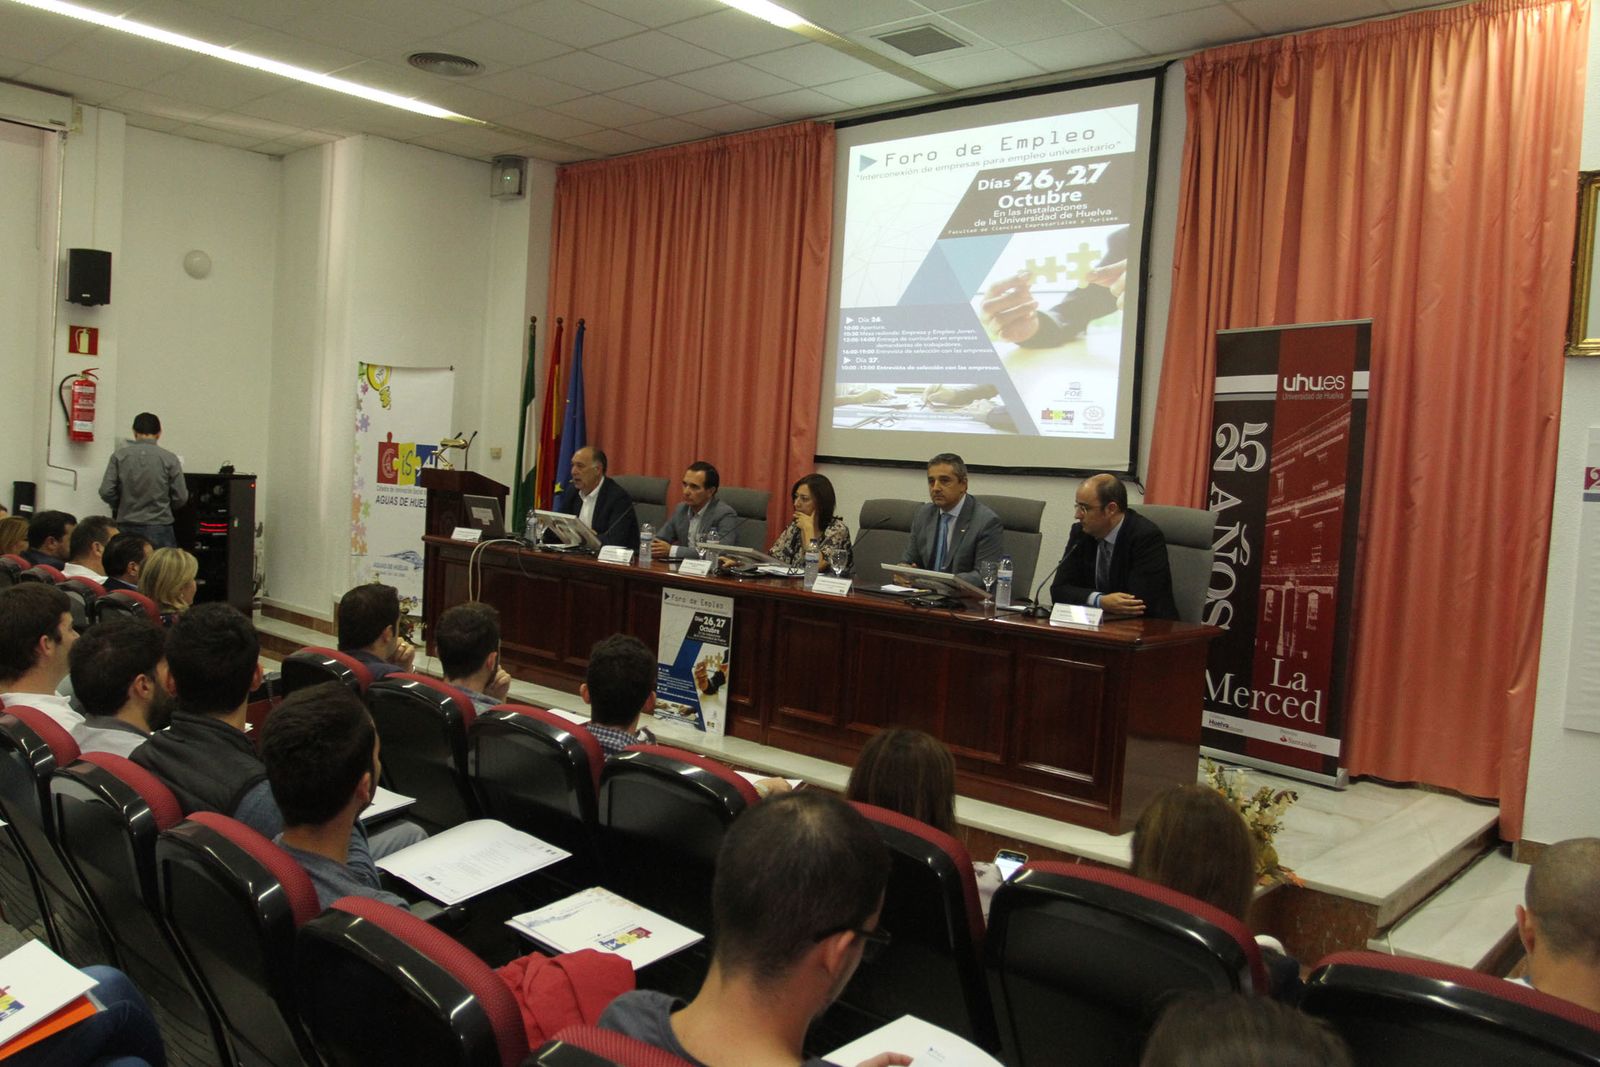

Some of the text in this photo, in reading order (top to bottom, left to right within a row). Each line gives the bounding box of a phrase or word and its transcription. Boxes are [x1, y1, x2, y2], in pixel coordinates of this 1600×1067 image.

[885, 128, 1095, 167] Foro de Empleo
[921, 165, 933, 174] de
[935, 159, 981, 173] empresas
[982, 156, 1005, 167] para
[1008, 151, 1046, 164] empleo
[978, 160, 1112, 192] Días 26 y 27
[993, 202, 1088, 218] En las instalaciones
[998, 190, 1083, 209] Octubre
[974, 206, 1113, 228] de la Universidad de Huelva
[1283, 373, 1345, 392] uhu.es
[1213, 422, 1268, 473] 25
[376, 495, 427, 508] AGUAS DE HUEL
[699, 625, 720, 635] Octubre
[1270, 657, 1308, 692] La
[1204, 669, 1321, 724] Merced
